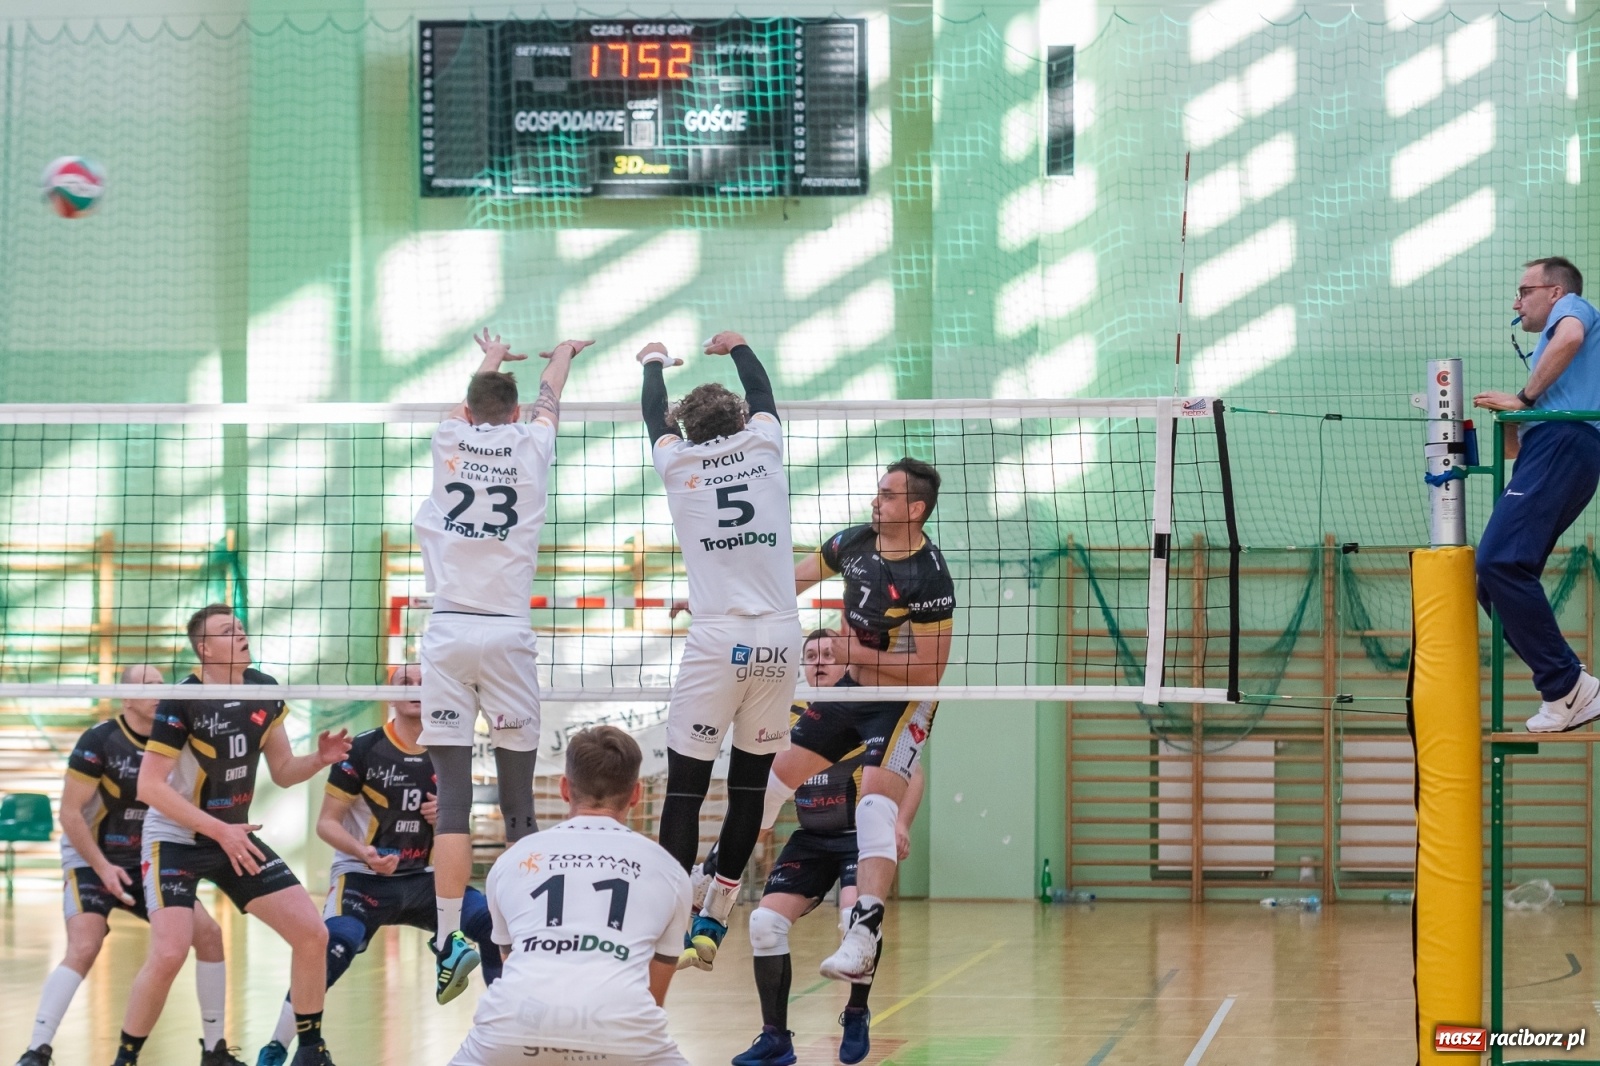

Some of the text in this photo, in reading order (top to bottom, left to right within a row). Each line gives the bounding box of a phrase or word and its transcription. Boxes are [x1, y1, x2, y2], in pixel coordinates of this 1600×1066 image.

[590, 24, 624, 36] CZAS
[632, 24, 665, 36] CZAS
[667, 24, 694, 36] GRY
[514, 111, 625, 132] GOSPODARZE
[684, 104, 748, 133] GOŚCIE
[458, 440, 512, 457] ŚWIDER
[702, 451, 745, 469] PYCIU
[460, 471, 518, 484] LUNATYCY
[444, 481, 519, 533] 23
[716, 484, 756, 528] 5
[700, 531, 777, 552] TropiDog
[859, 585, 872, 609] 7
[755, 646, 789, 663] DK
[736, 662, 787, 683] glass
[229, 733, 248, 759] 10
[225, 765, 248, 781] ENTER
[382, 764, 409, 788] Hair
[401, 789, 422, 811] 13
[395, 820, 420, 833] ENTER
[549, 862, 640, 880] LUNATYCY
[530, 874, 629, 932] 11
[522, 934, 630, 961] TropiDog
